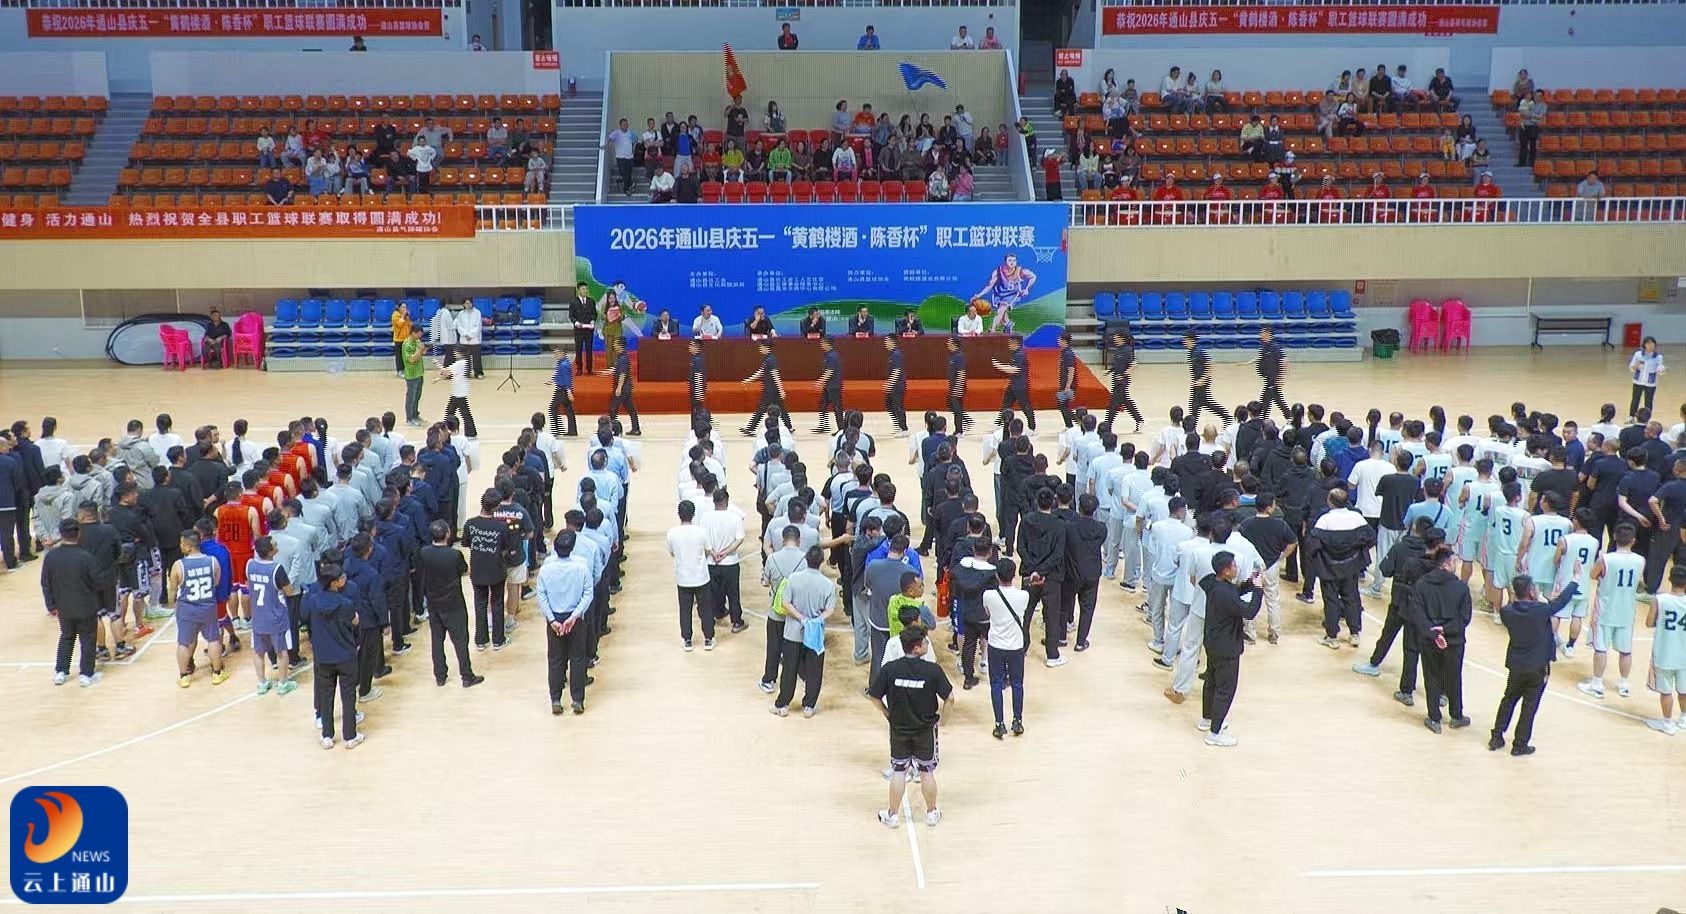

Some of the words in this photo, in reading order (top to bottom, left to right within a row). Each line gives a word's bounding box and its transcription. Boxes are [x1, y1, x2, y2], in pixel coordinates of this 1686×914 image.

[1, 212, 35, 227] 健身
[45, 212, 113, 227] 活力通山
[1502, 518, 1512, 536] 3
[1578, 547, 1589, 565] 9
[1617, 568, 1634, 587] 11
[185, 576, 213, 602] 32
[253, 583, 266, 606] 7
[1664, 609, 1686, 631] 24
